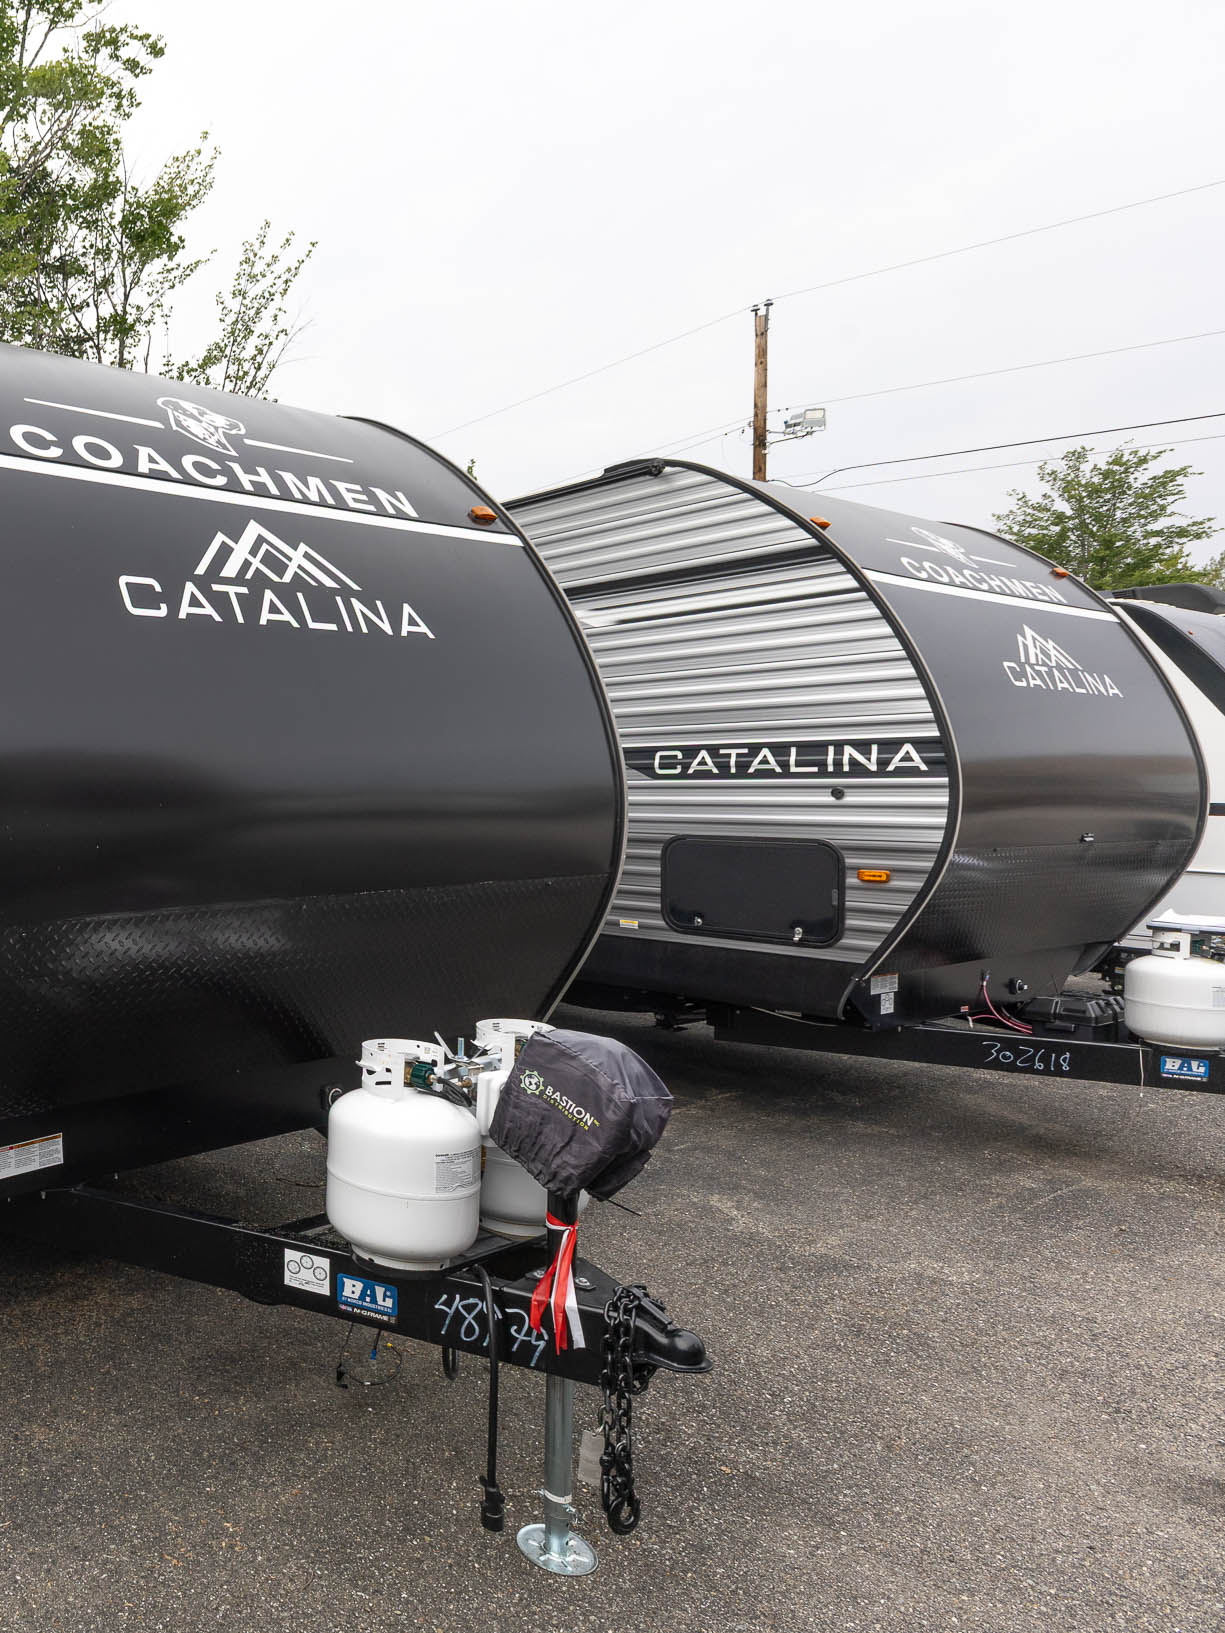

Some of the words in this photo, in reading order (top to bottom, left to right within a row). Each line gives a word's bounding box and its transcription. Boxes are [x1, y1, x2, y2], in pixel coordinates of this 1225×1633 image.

[9, 424, 419, 518] COACHMEN
[900, 556, 1068, 604] COACHMEN
[118, 574, 435, 639] CATALINA
[1002, 661, 1124, 698] CATALINA
[654, 743, 928, 775] CATALINA
[981, 1041, 1070, 1071] 302618
[545, 1085, 594, 1126] BASTION
[342, 1277, 393, 1308] BAL
